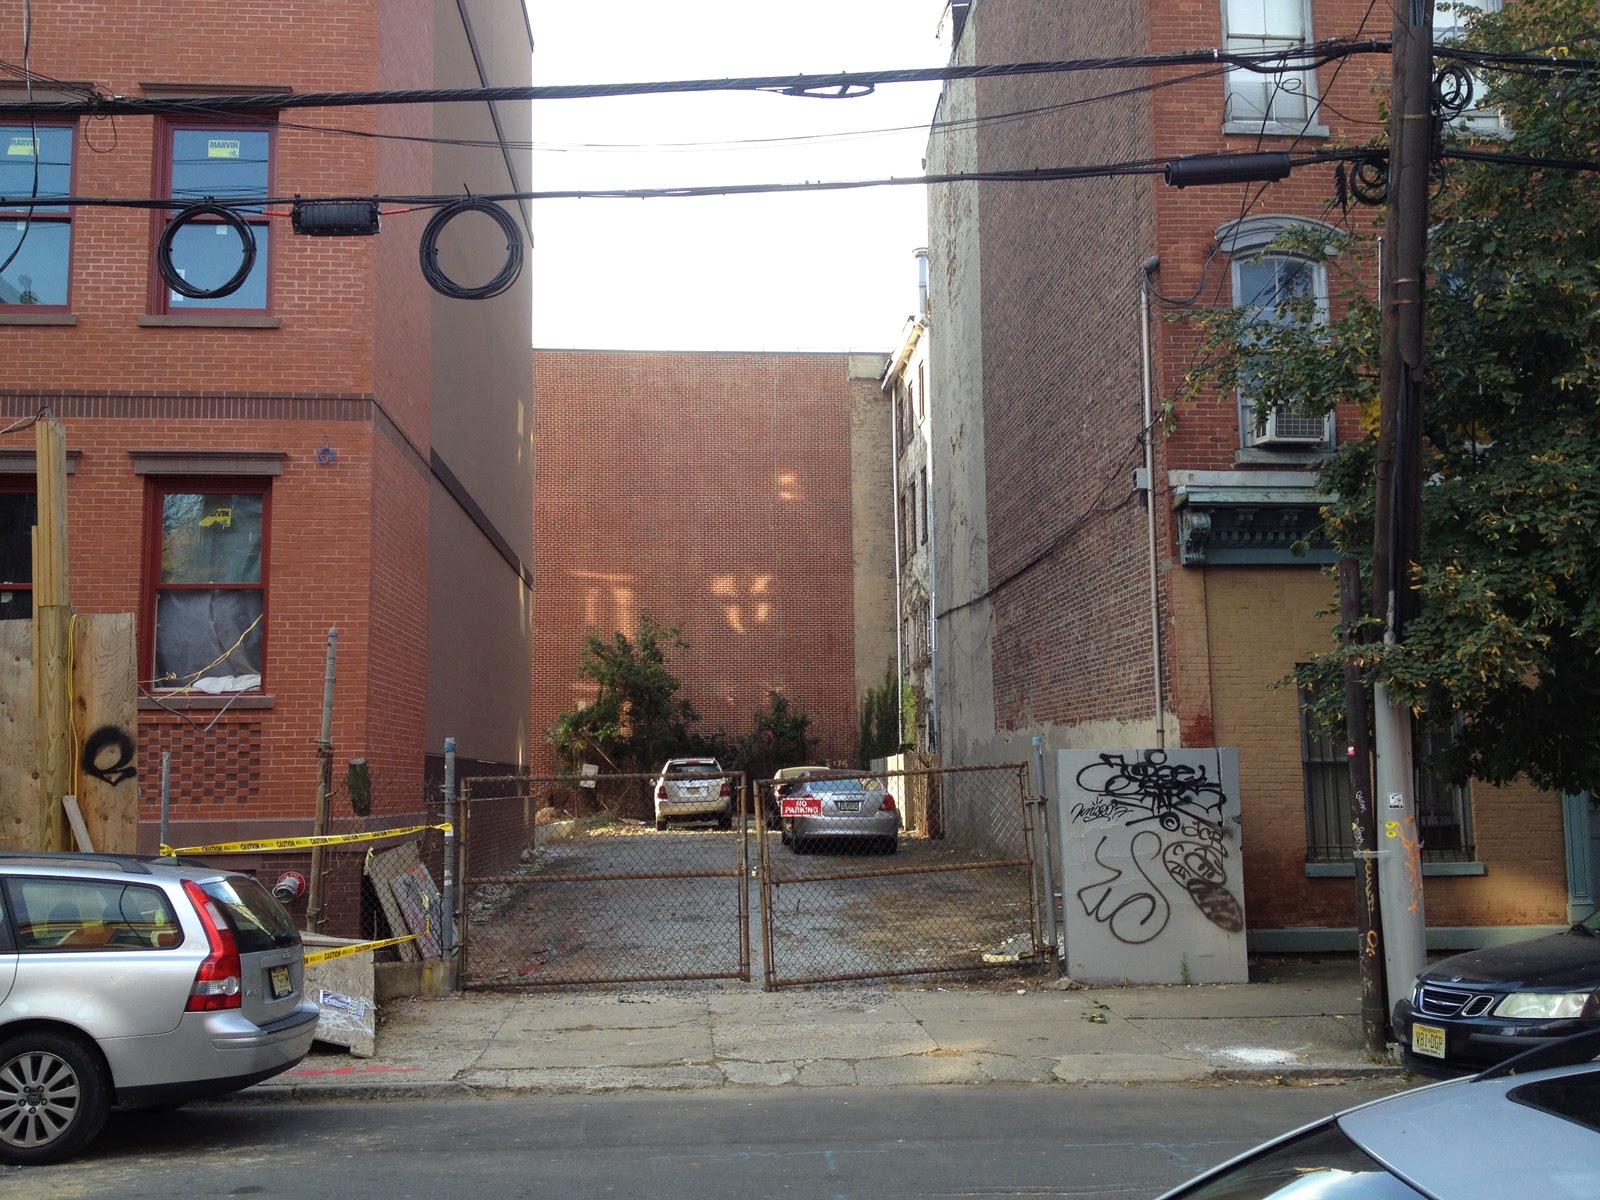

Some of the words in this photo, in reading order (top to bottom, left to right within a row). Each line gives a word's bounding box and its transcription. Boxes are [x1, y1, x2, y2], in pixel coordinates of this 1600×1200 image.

[209, 141, 239, 149] MARVIN
[785, 806, 818, 814] PARKING
[240, 842, 261, 851] CAUTION
[276, 840, 297, 848] CAUTION
[341, 834, 359, 842] CAUTION
[371, 830, 388, 838] CAUTION
[324, 950, 341, 960] CAUTION
[355, 944, 371, 953] CAUTION
